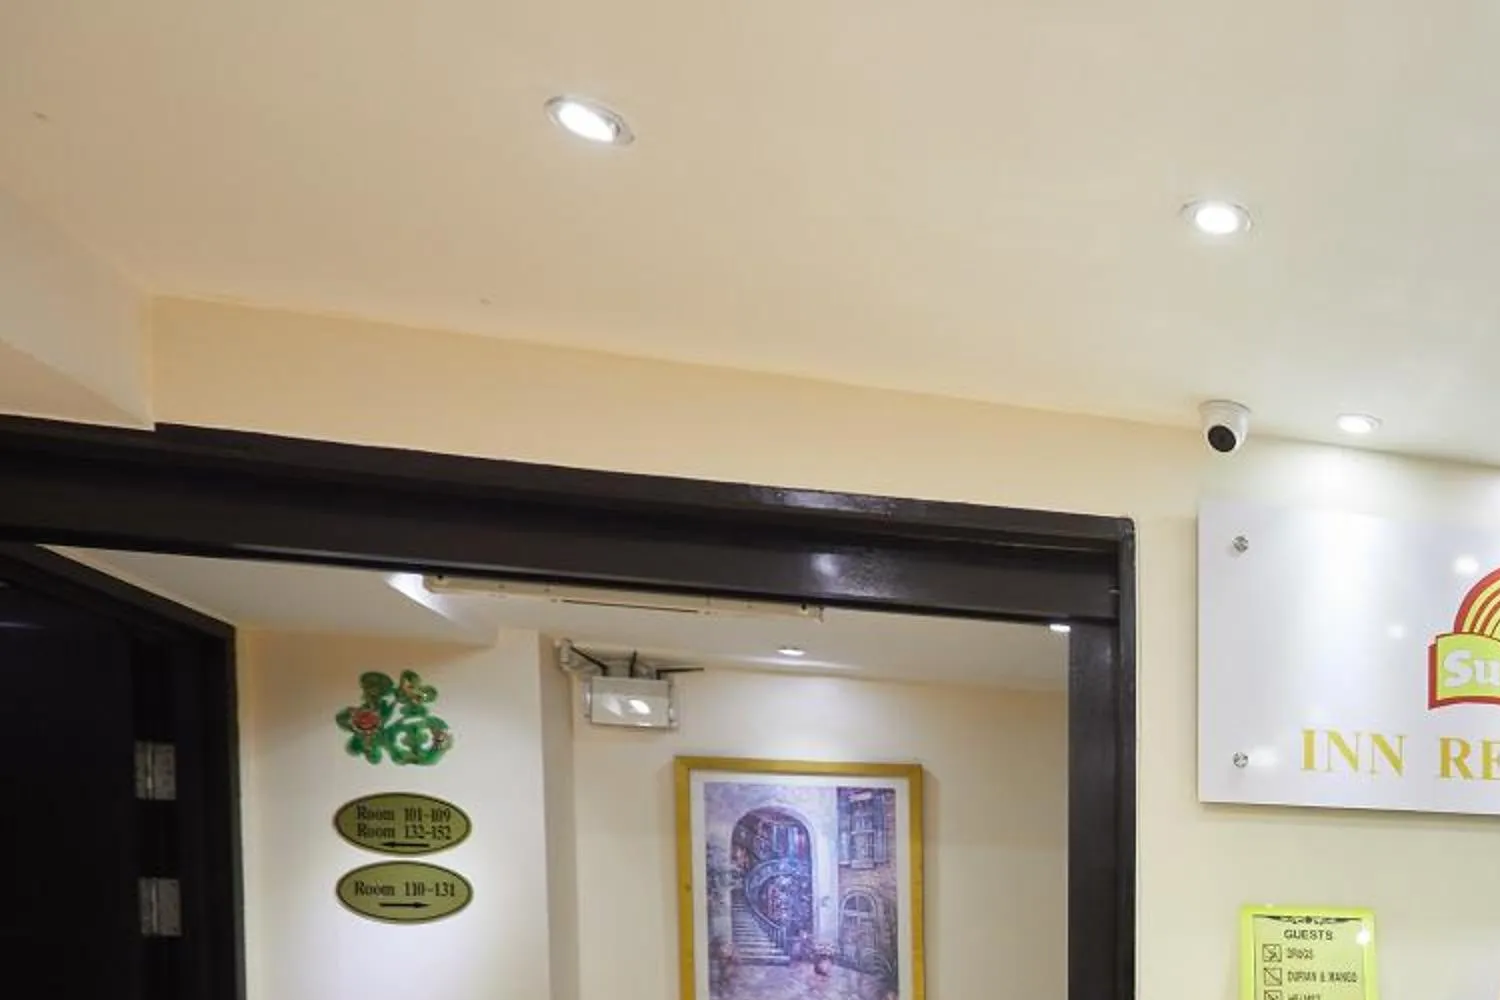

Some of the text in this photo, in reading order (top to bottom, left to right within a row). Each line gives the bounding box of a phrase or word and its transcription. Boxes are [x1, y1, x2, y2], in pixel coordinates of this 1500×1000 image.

[1301, 728, 1405, 776] INN
[356, 805, 451, 822] Room 101-109
[356, 823, 396, 838] Room
[354, 881, 455, 897] Room 110-131
[1283, 929, 1334, 941] GUESTS
